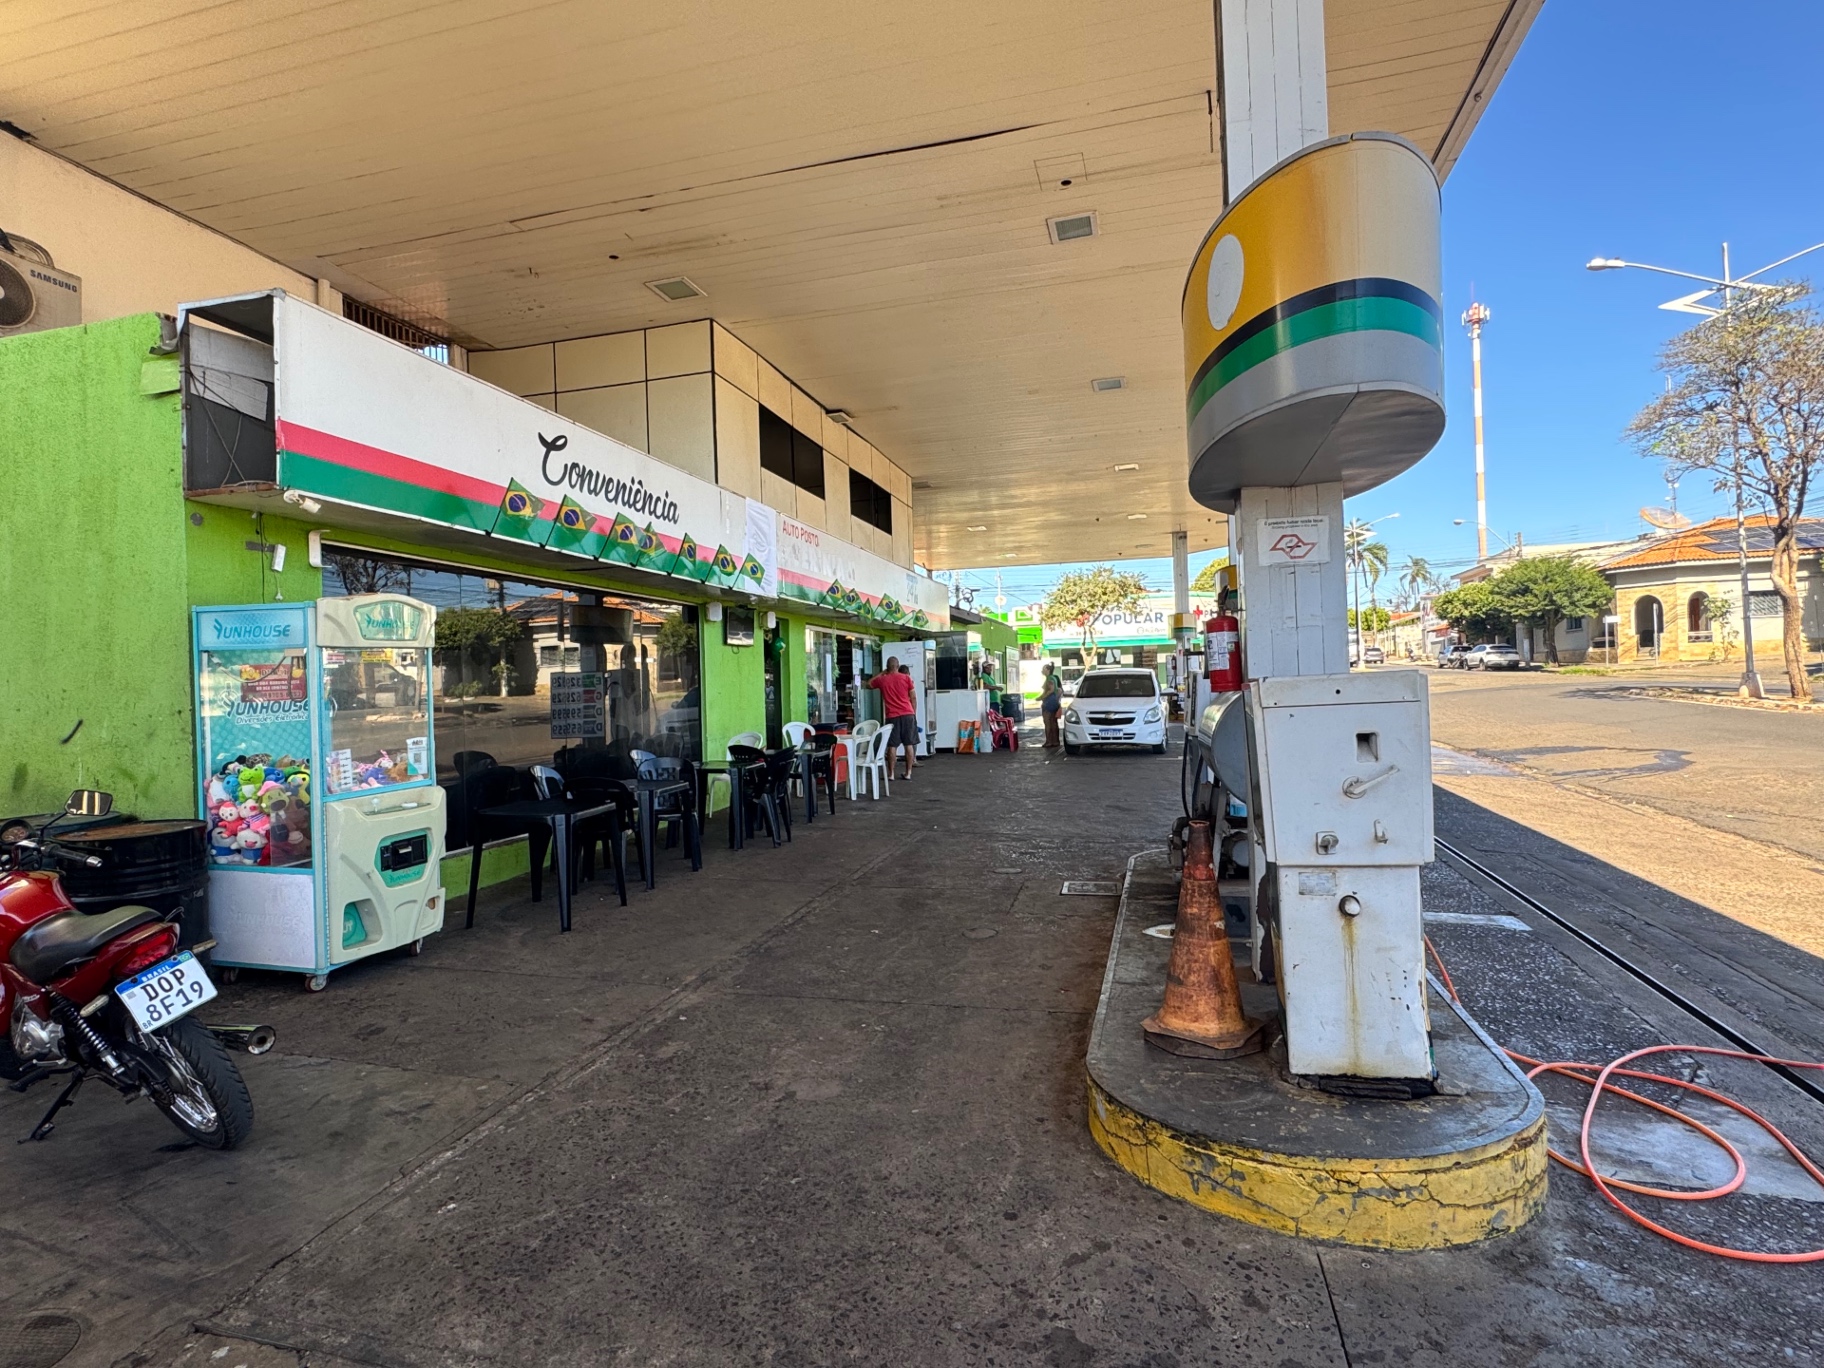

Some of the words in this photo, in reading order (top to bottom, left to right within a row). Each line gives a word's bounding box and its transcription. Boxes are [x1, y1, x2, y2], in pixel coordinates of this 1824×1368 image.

[30, 269, 78, 293] SAMSUNG
[538, 432, 680, 525] Conveniência
[782, 520, 799, 540] AUTO
[800, 527, 819, 548] POSTO
[213, 618, 292, 640] YUNHOUSE
[1093, 611, 1164, 626] OPULAR
[139, 968, 185, 1002] DOP
[141, 964, 172, 983] BRASIL
[146, 980, 204, 1022] 8F19
[142, 1020, 154, 1030] BR
